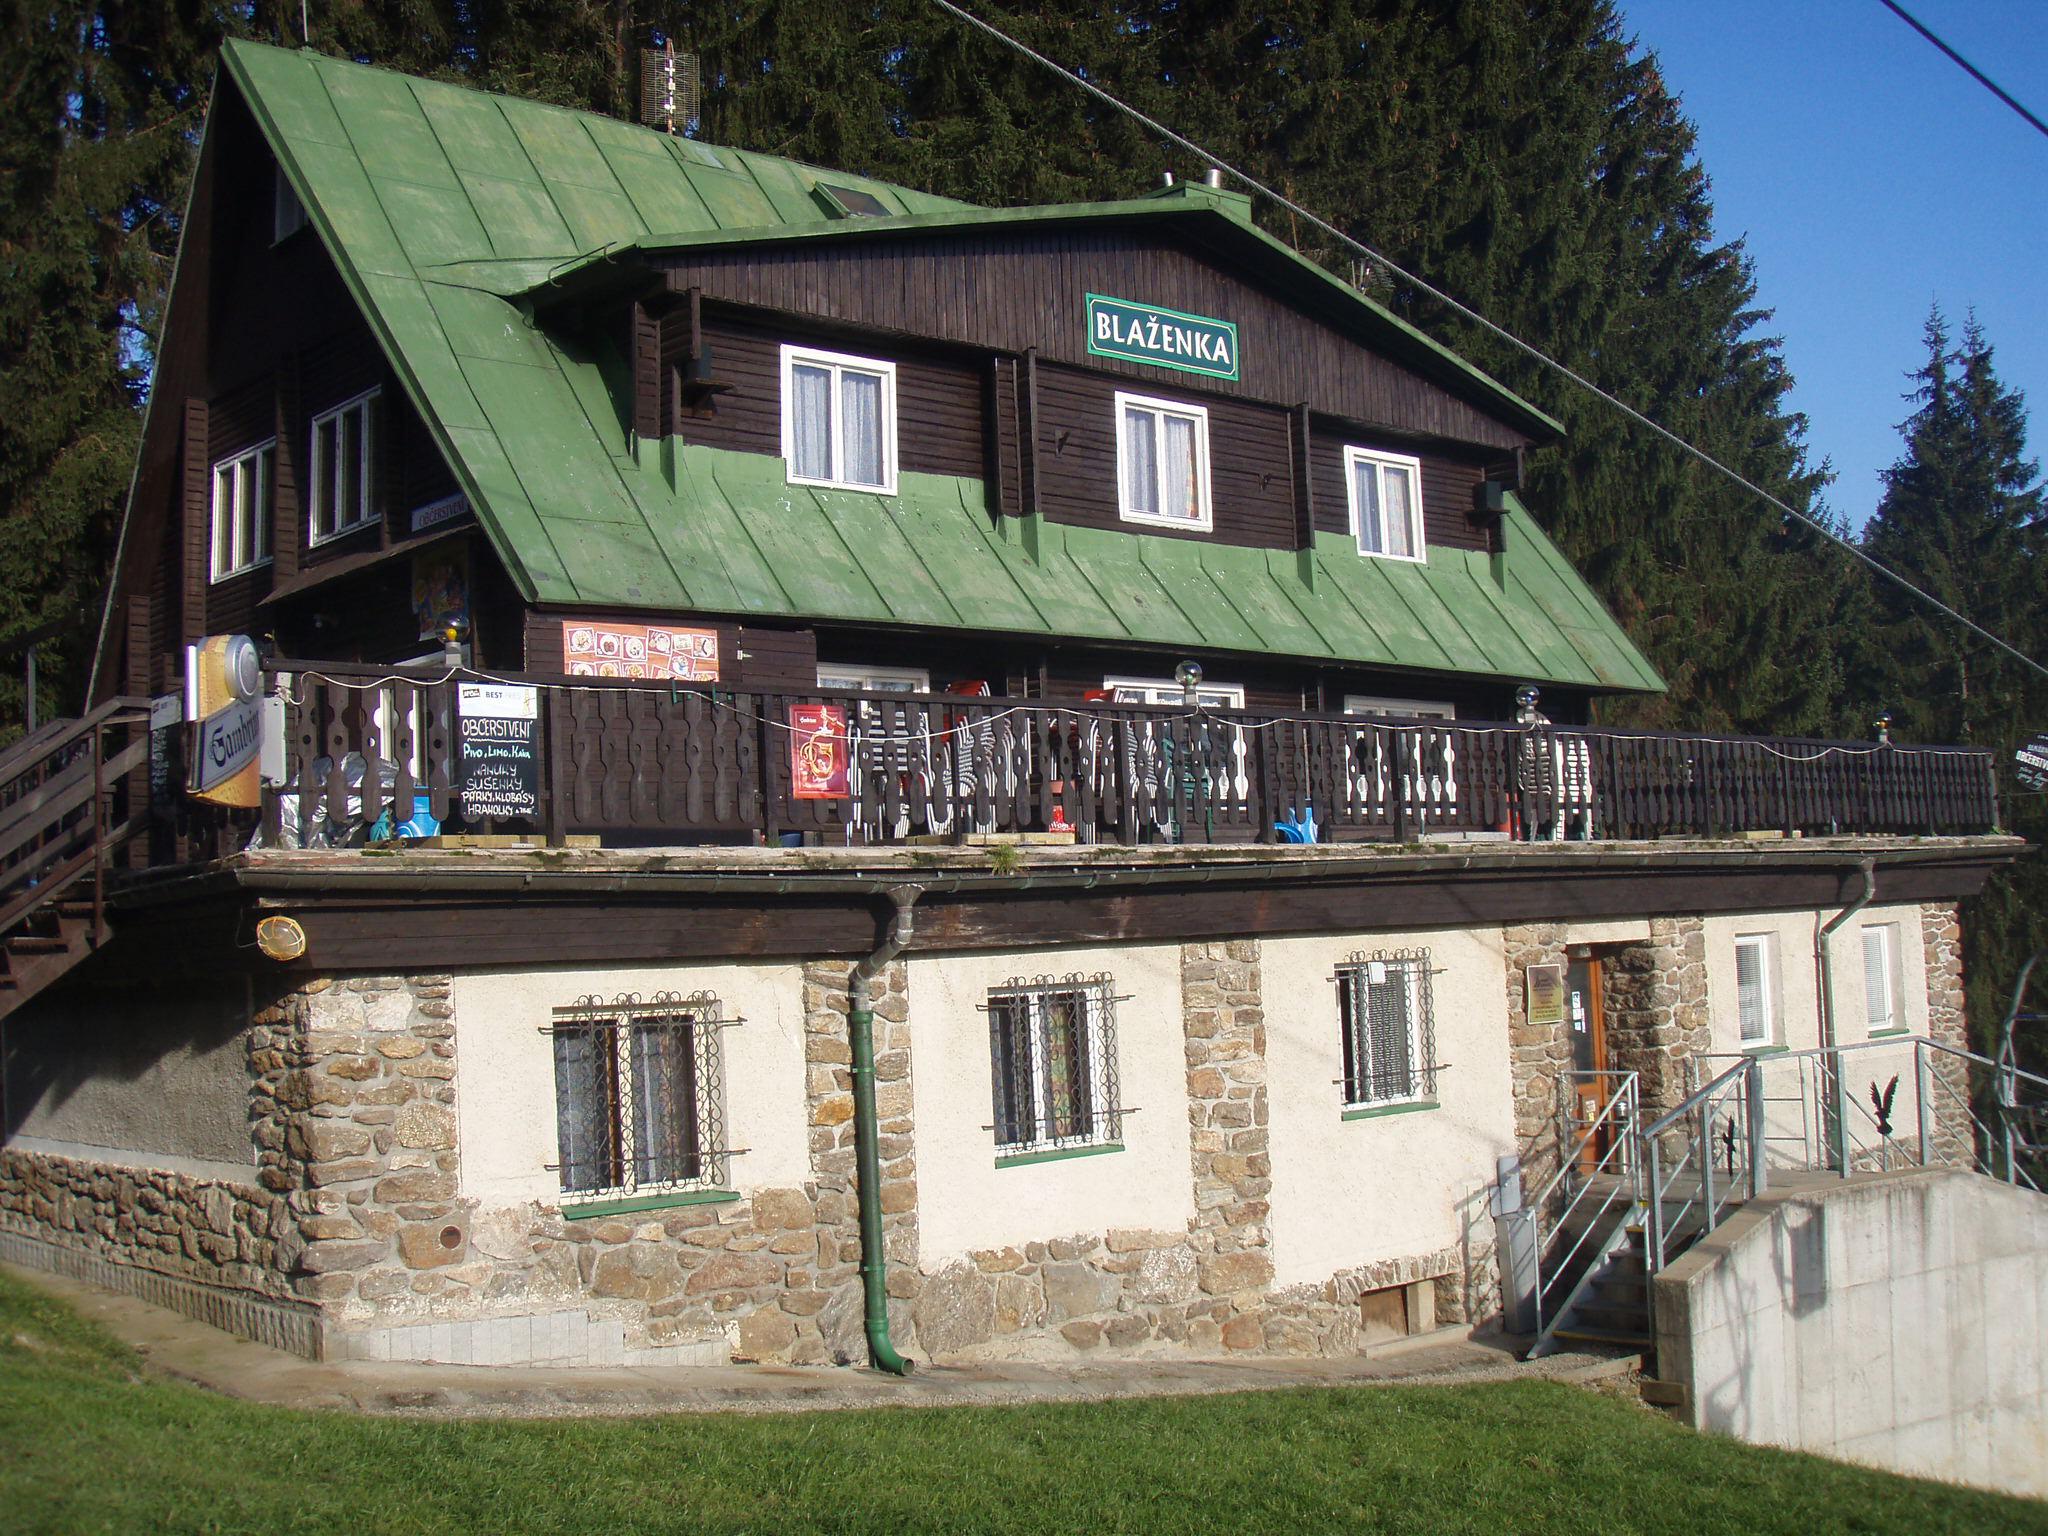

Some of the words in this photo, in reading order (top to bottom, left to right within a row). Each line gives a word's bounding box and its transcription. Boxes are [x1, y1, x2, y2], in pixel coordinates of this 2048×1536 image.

[1096, 311, 1231, 364] BLAŽENKA
[486, 691, 503, 699] BEST
[462, 718, 533, 738] OBČERSTVENÍ
[466, 776, 522, 791] SUŠENKY
